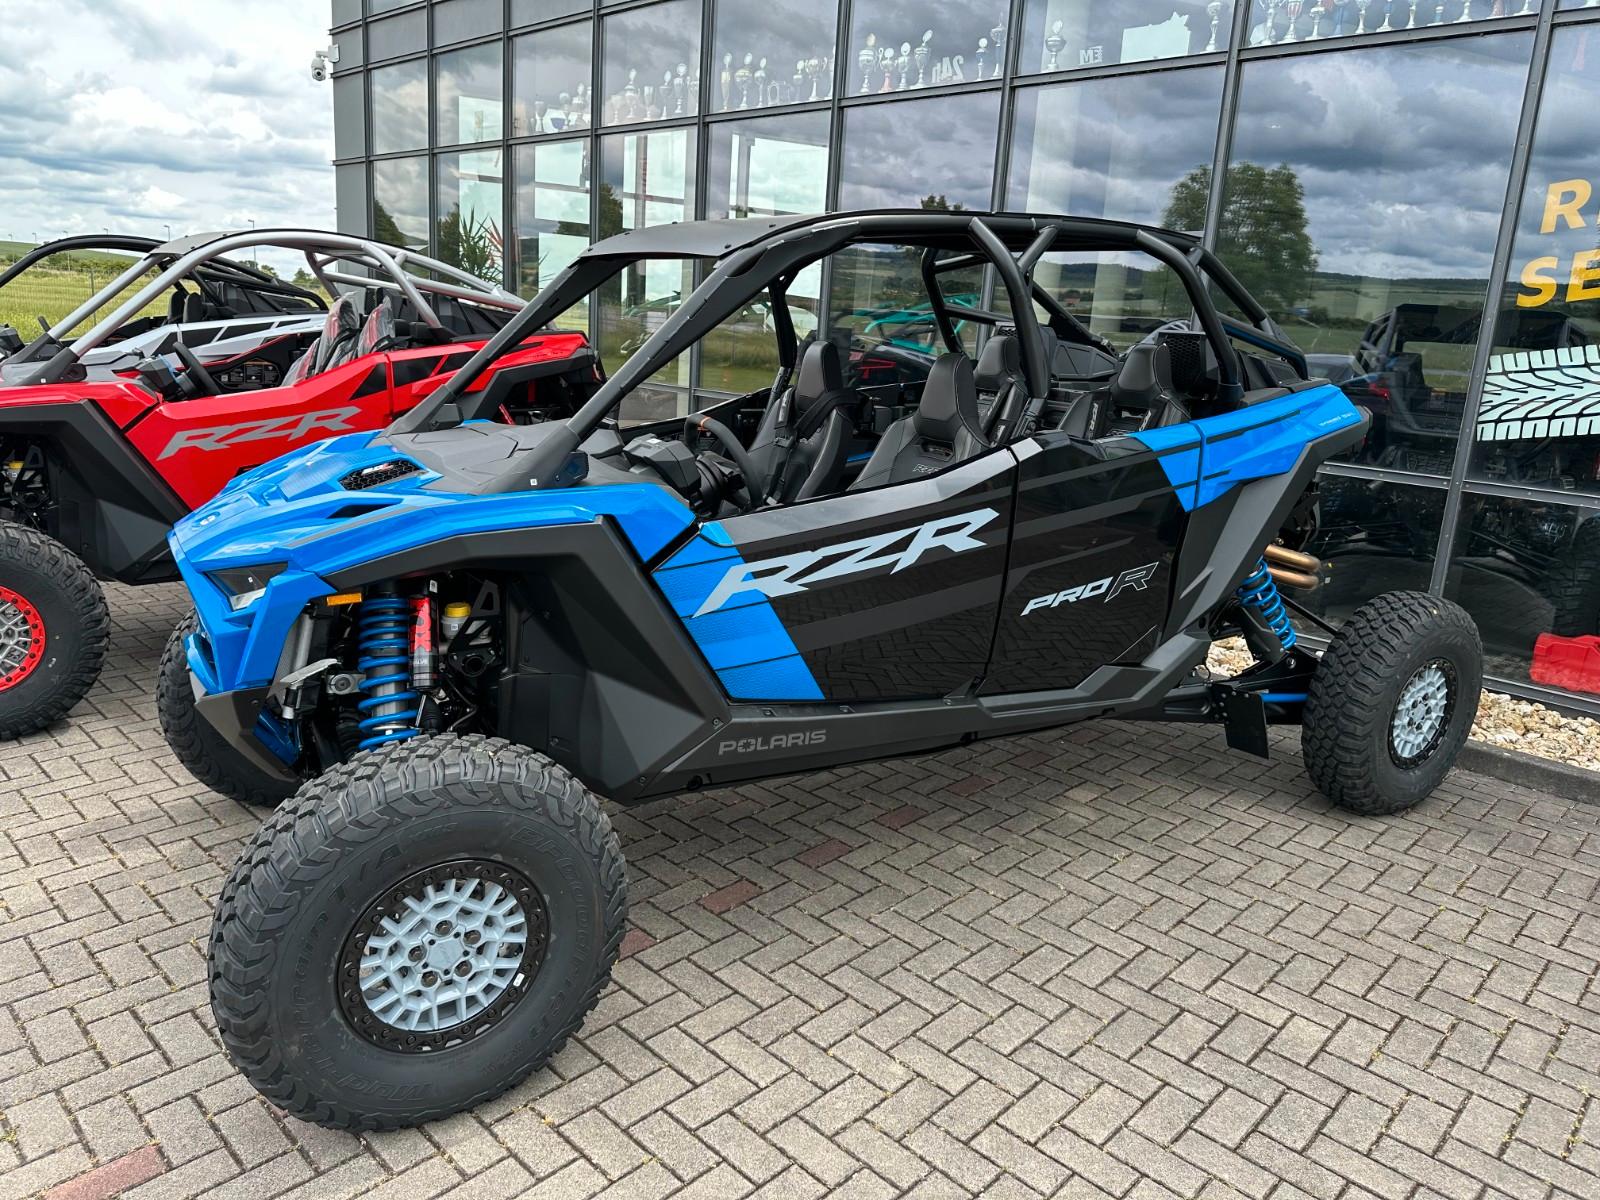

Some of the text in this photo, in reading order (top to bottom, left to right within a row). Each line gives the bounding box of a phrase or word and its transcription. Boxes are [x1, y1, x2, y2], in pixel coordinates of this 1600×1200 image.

[1540, 178, 1600, 234] R
[156, 405, 362, 461] RZR
[692, 507, 1000, 619] RZR
[717, 729, 828, 756] POLARIS
